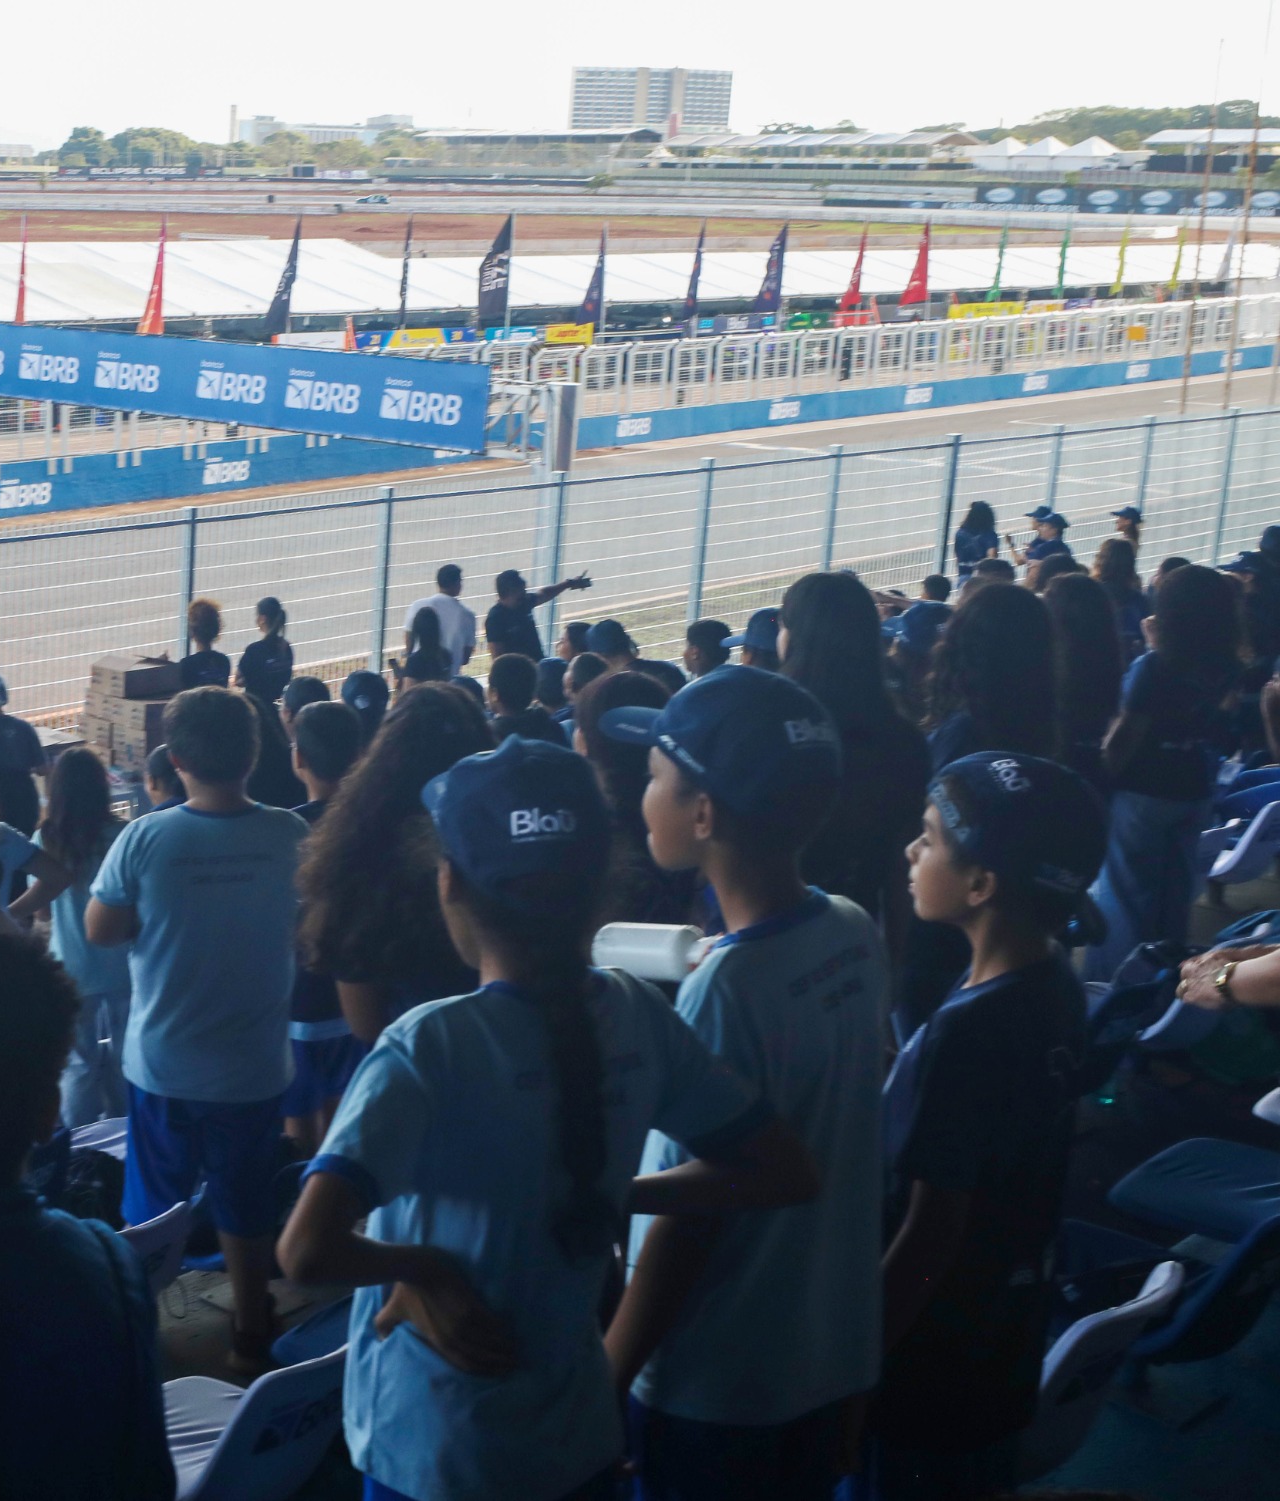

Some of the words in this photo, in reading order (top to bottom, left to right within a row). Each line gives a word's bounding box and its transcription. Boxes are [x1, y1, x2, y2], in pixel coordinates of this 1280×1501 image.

[40, 355, 80, 384] BRB
[118, 363, 160, 393] BRB
[220, 372, 267, 405] BRB
[309, 380, 361, 414] BRB
[407, 391, 463, 426] BRB
[220, 460, 250, 482] BRB
[16, 482, 52, 507] BRB
